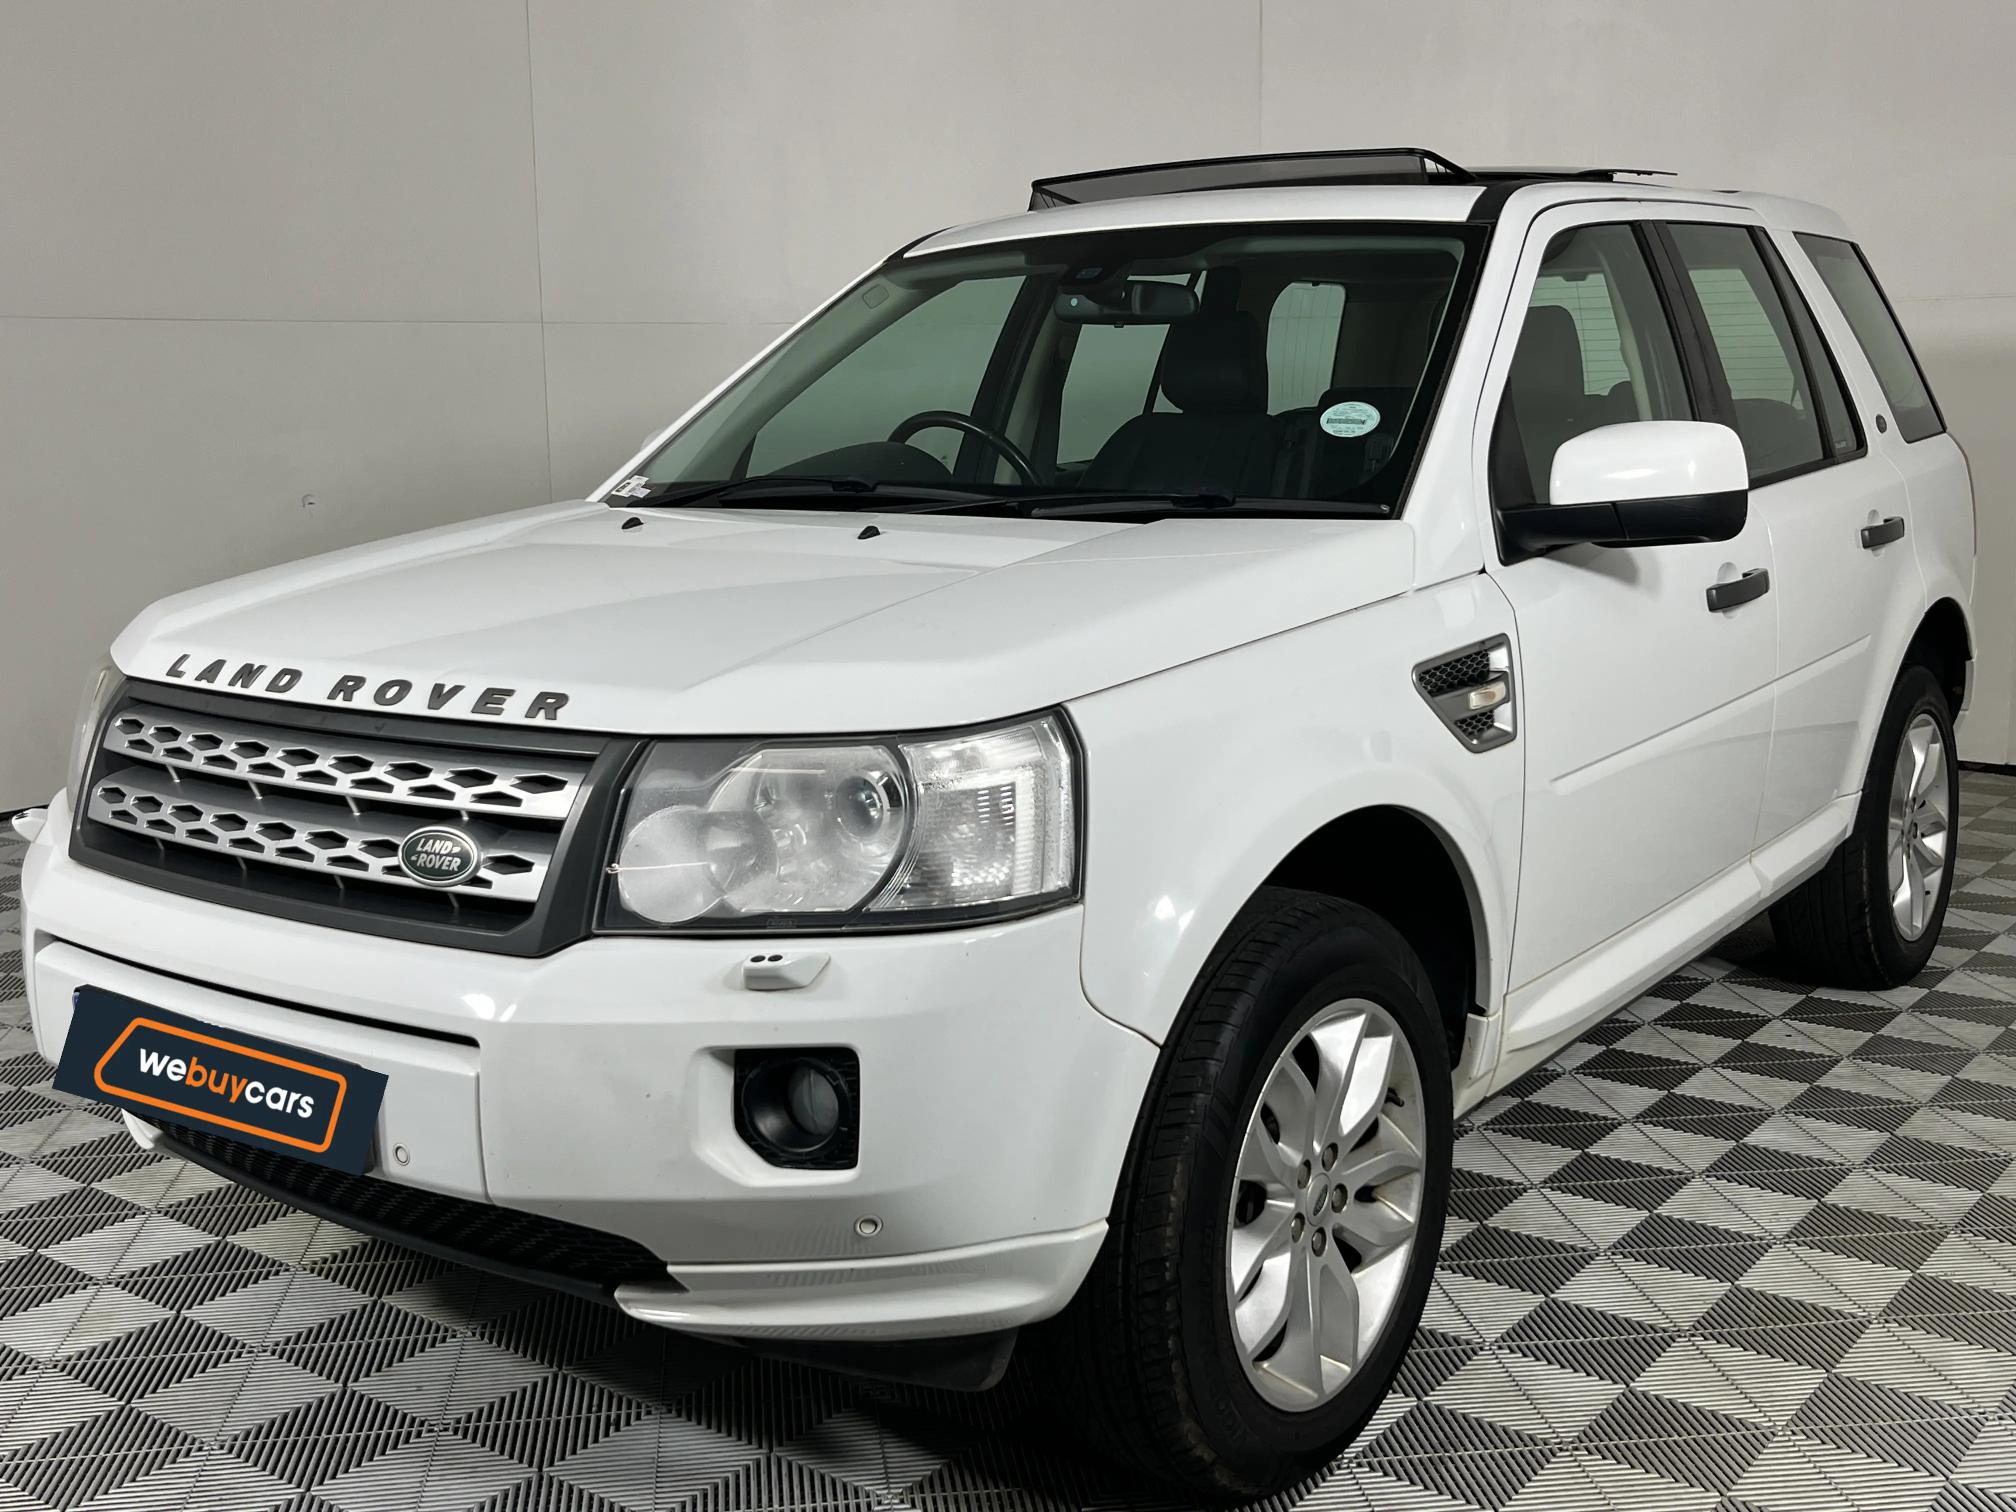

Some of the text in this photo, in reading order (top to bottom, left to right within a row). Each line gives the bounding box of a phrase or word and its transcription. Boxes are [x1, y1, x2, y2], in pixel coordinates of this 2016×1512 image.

[165, 653, 570, 721] LAND ROVER
[415, 837, 454, 855] LAND
[416, 853, 462, 872] ROVER
